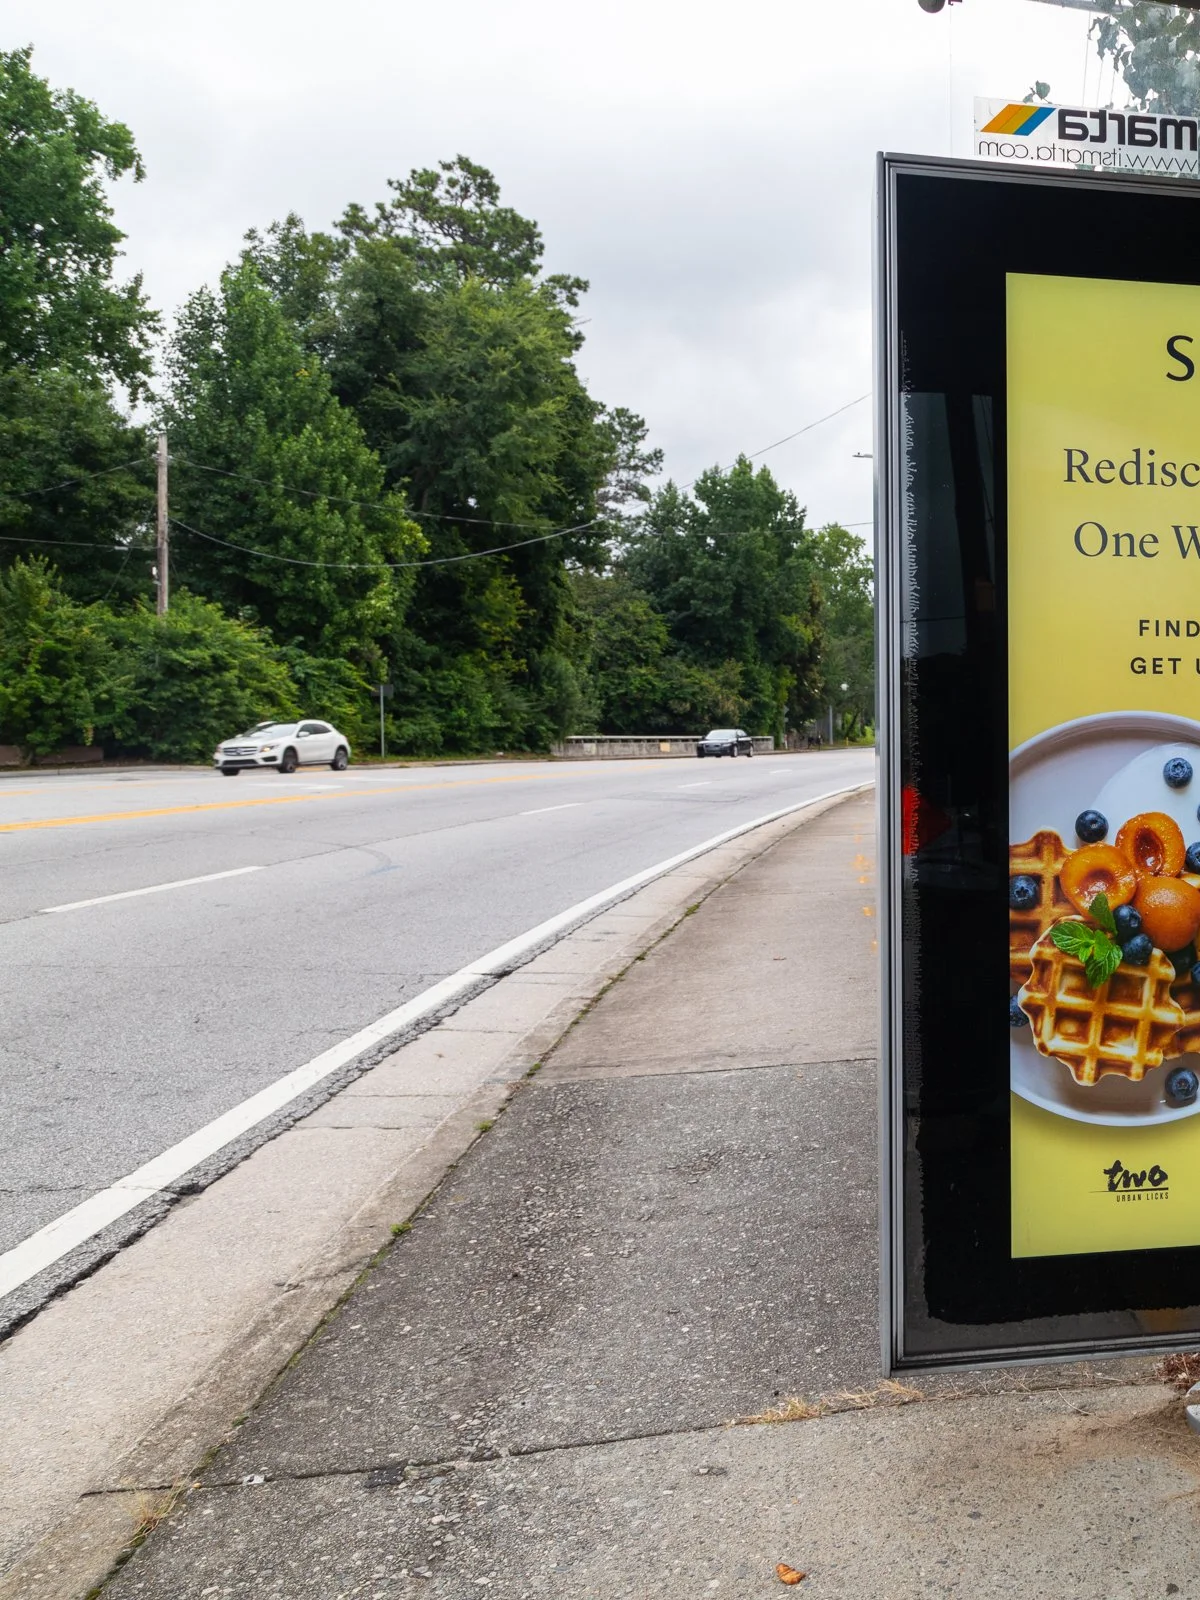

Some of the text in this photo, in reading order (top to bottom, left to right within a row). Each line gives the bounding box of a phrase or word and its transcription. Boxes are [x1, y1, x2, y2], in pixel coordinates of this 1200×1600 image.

[1074, 522, 1159, 557] One
[1139, 620, 1200, 637] FIND
[1130, 657, 1181, 675] GET
[1103, 1160, 1168, 1192] two
[1116, 1192, 1169, 1203] URBAN LICKS
